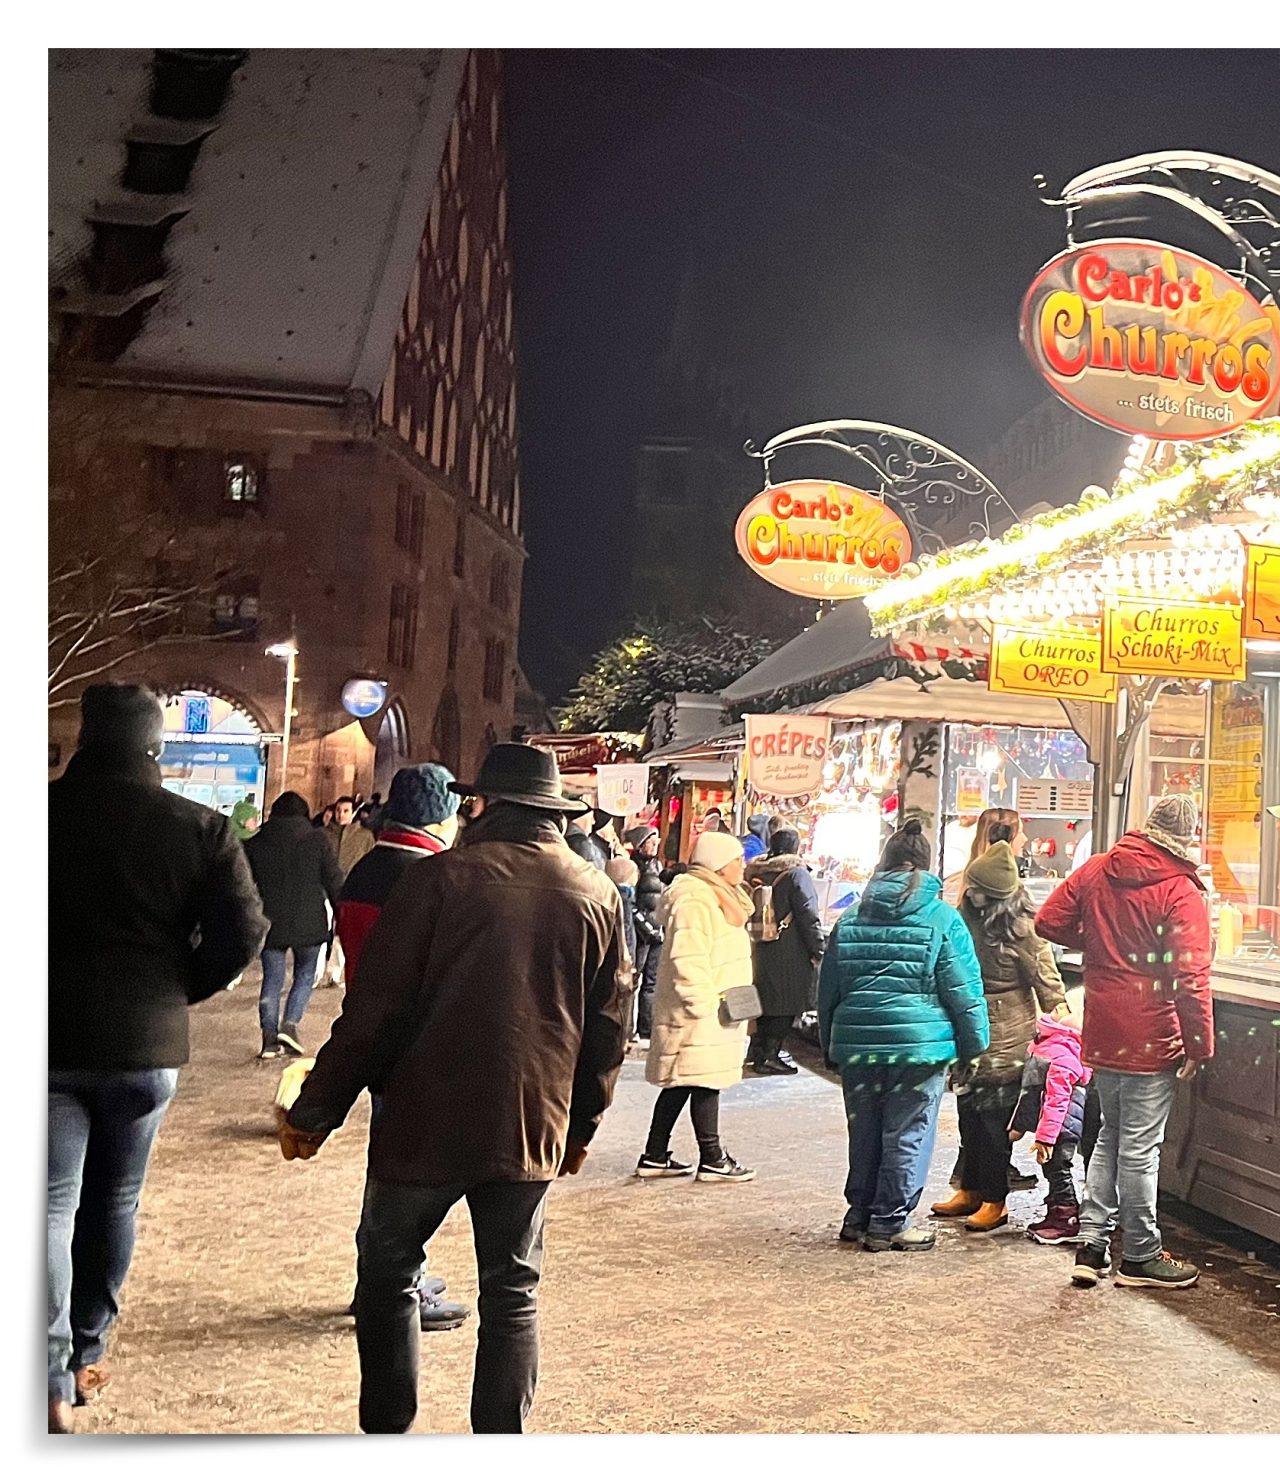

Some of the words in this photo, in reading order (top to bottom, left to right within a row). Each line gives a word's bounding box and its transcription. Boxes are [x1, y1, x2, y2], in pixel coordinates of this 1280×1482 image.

[1077, 253, 1202, 310] Carlo's
[1040, 290, 1272, 401] Churros
[1139, 393, 1181, 414] stets
[1185, 397, 1235, 423] frisch
[771, 490, 854, 521] Carlo's
[747, 515, 902, 573] Churros
[1134, 608, 1220, 636] Churros
[1018, 638, 1097, 664] Churros
[1116, 635, 1234, 668] Schoki-Mix
[1023, 662, 1090, 688] OREO
[751, 723, 827, 761] CRÉPES
